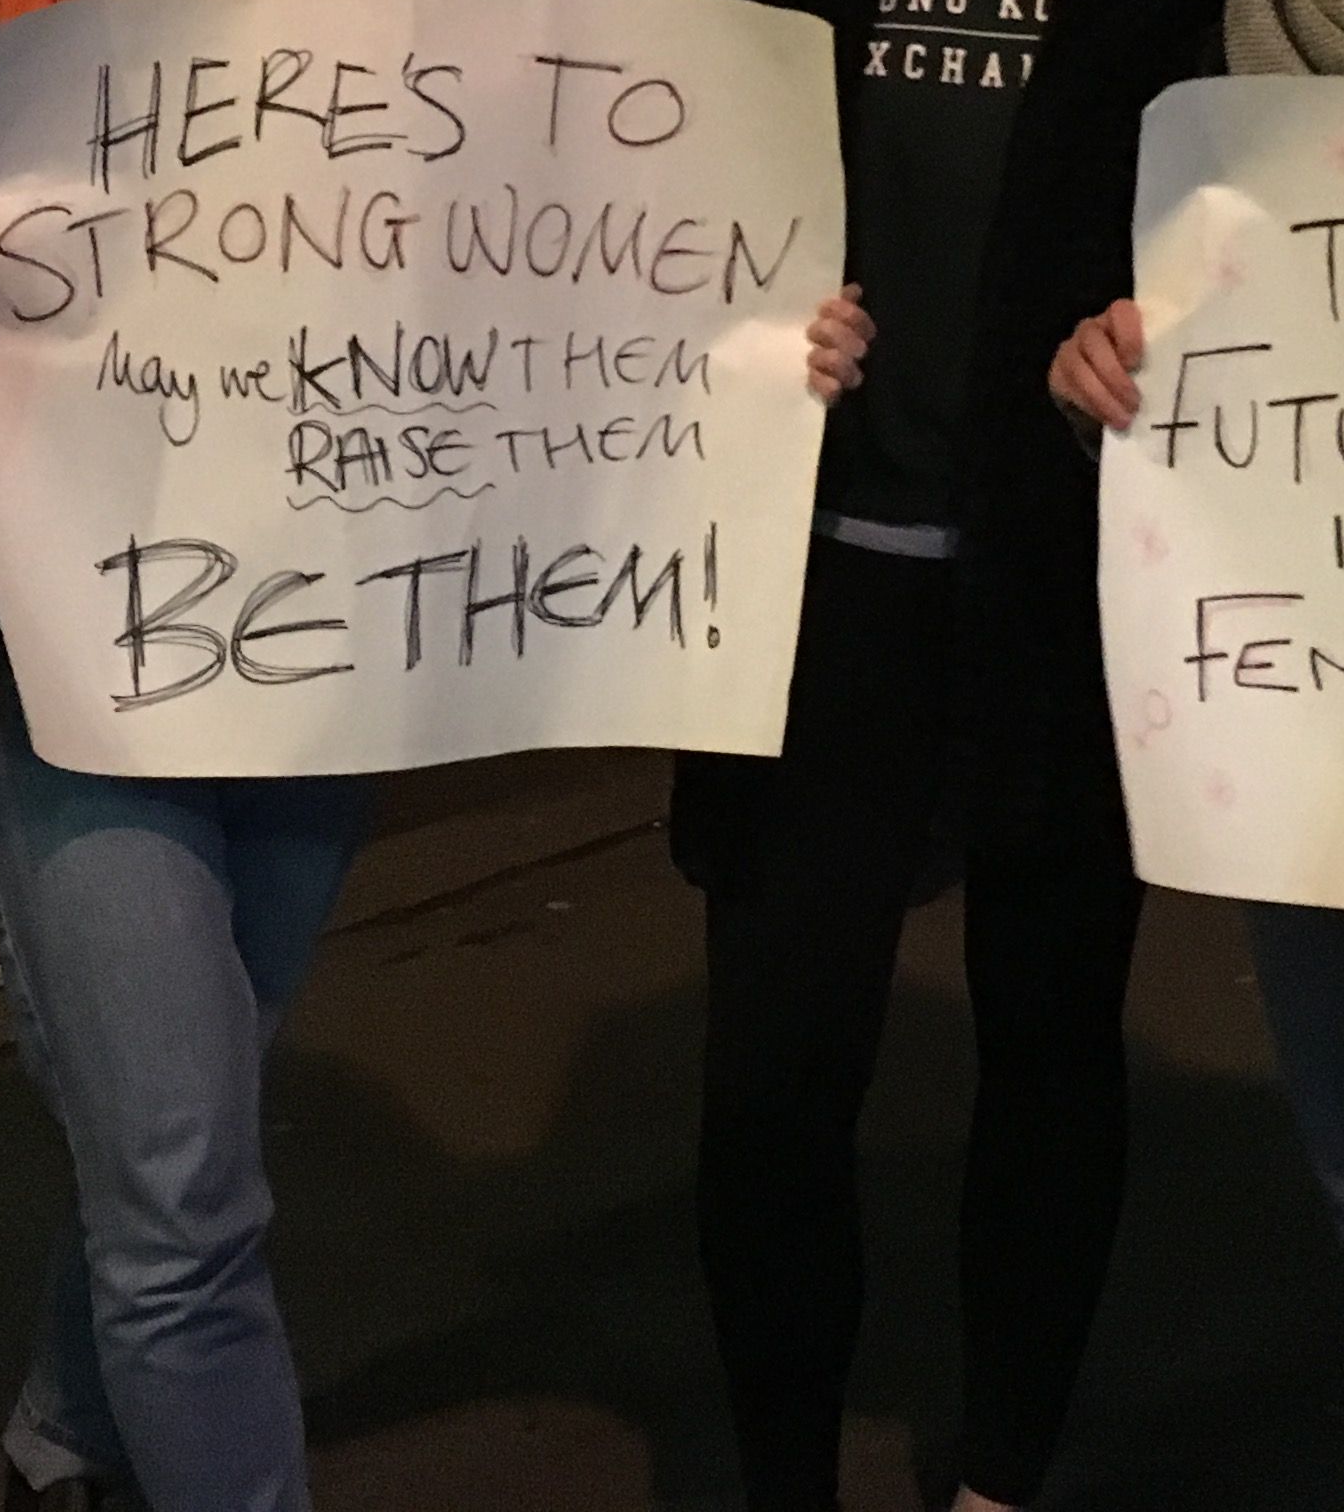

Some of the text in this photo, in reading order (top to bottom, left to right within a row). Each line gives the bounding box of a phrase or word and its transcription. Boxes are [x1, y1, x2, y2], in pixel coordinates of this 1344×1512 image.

[87, 48, 686, 194] HERE'S TO
[445, 182, 802, 305] WOMEN
[220, 355, 287, 402] we
[287, 320, 498, 412] KNOW
[511, 333, 712, 394] THEM
[287, 414, 707, 491] RAISE THEM
[94, 520, 721, 712] BE THEM!
